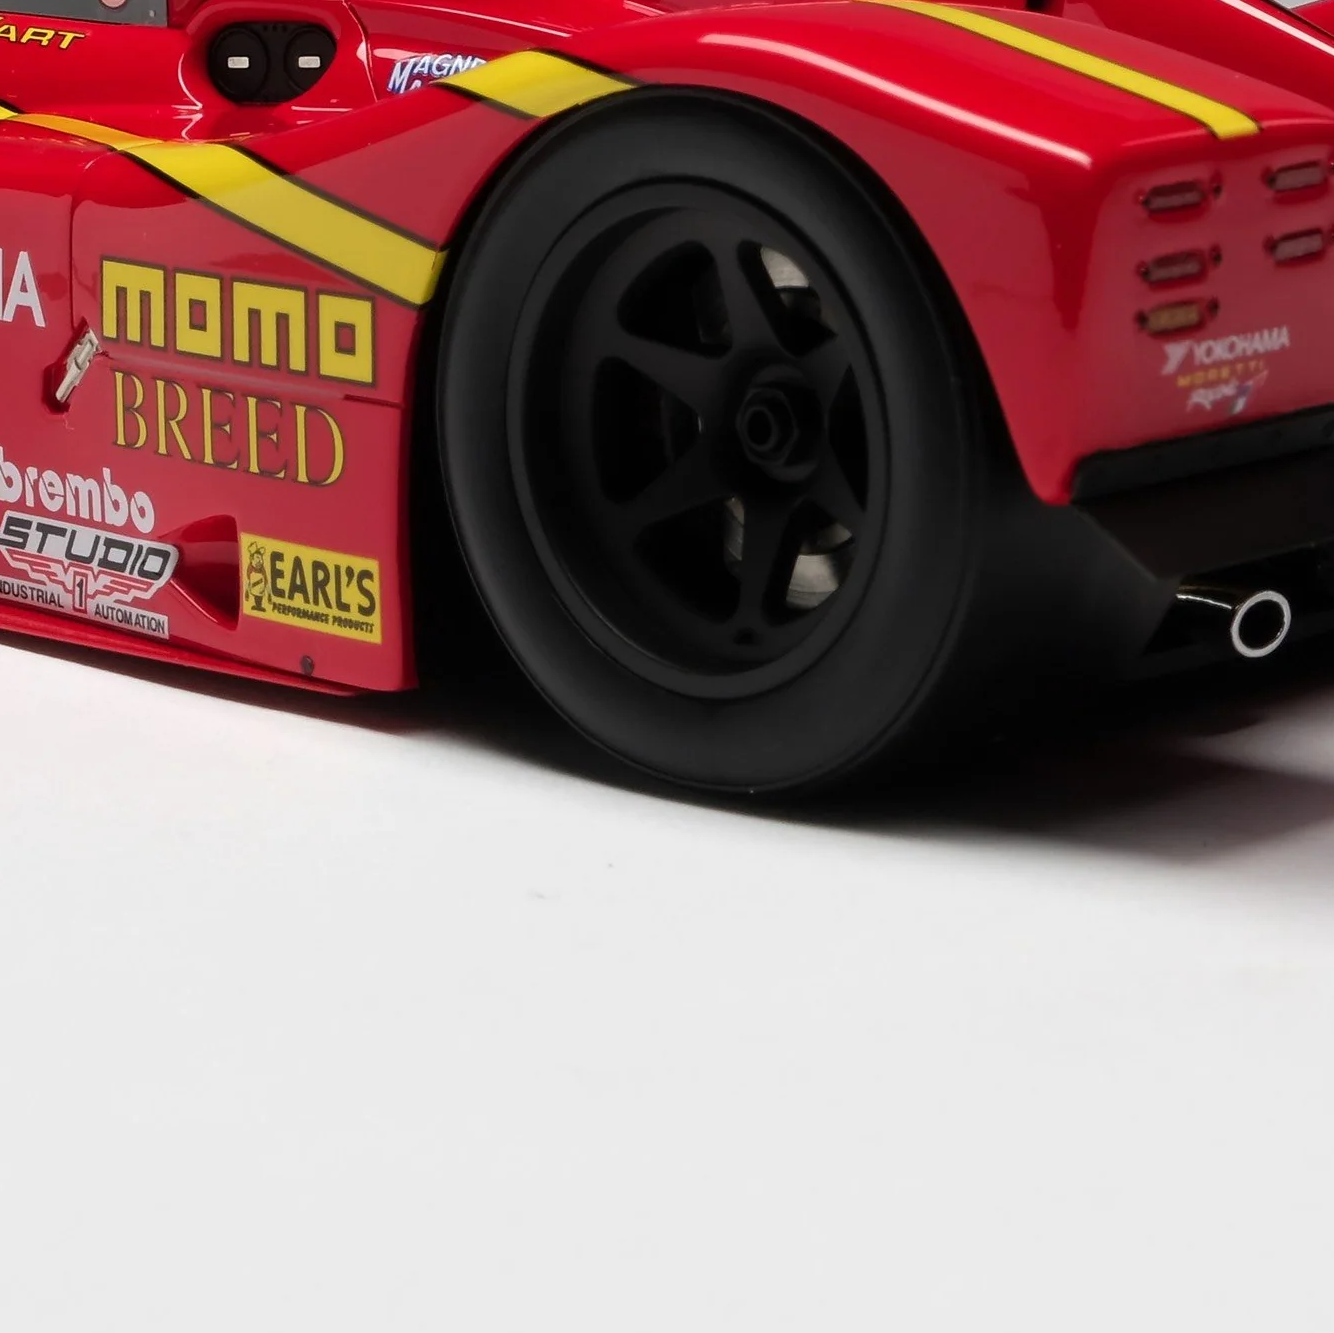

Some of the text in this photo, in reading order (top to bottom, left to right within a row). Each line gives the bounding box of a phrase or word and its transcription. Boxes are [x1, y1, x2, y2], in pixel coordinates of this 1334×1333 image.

[1193, 325, 1290, 365] YOKOHAMA
[111, 369, 347, 487] BREED
[270, 550, 376, 617] EARL'S
[94, 603, 165, 634] AUTOMATION
